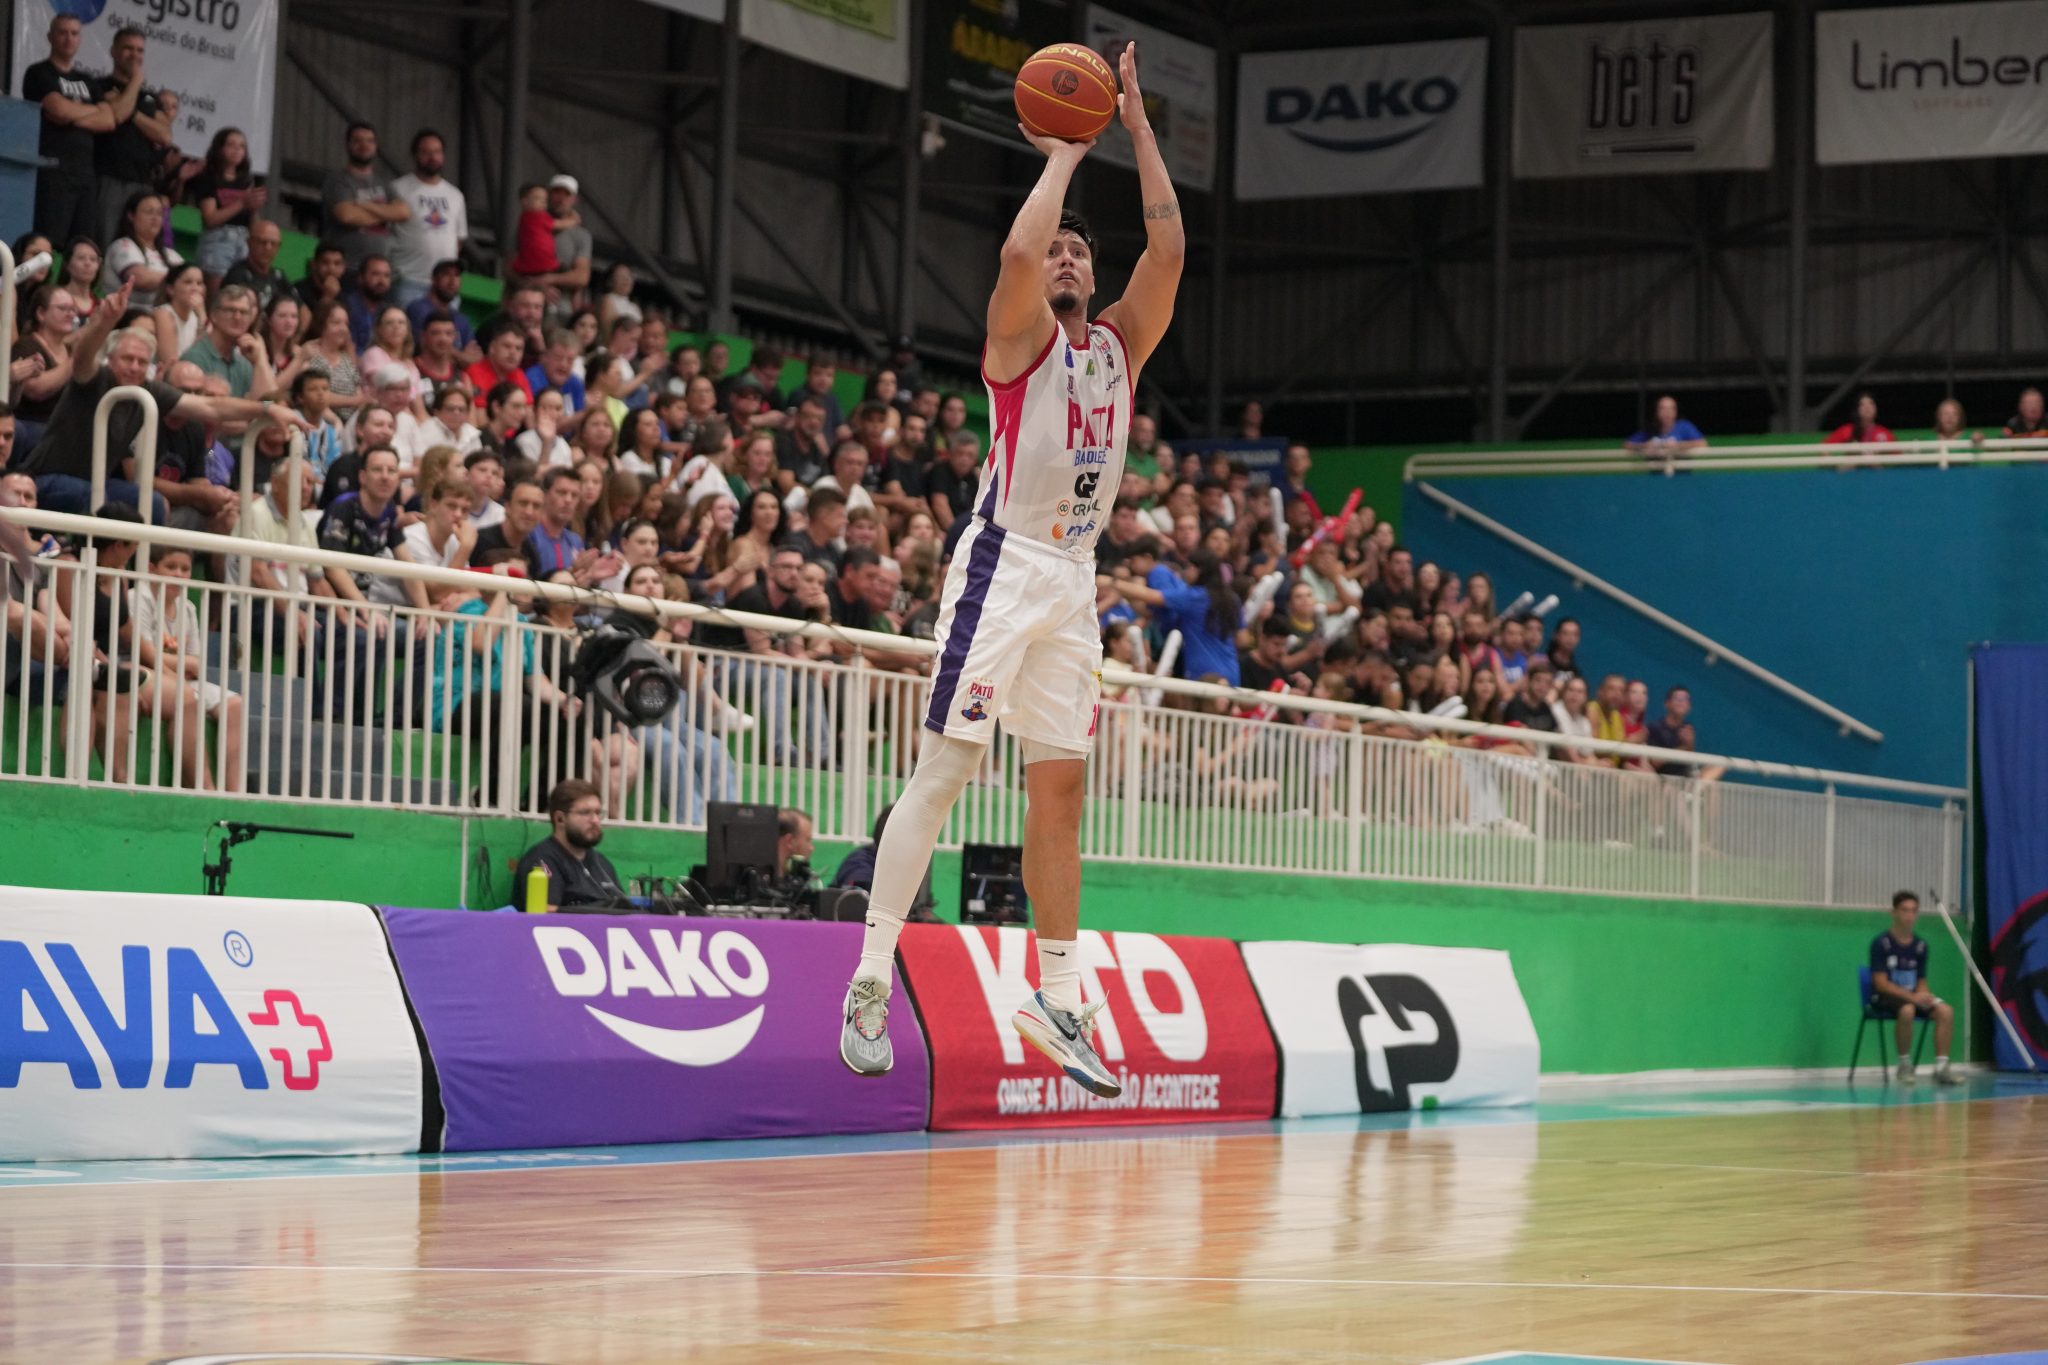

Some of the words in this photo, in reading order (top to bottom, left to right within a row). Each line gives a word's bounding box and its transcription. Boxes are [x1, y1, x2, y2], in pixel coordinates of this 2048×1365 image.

[1033, 46, 1116, 88] PENALTY
[1588, 42, 1697, 129] bets
[1266, 76, 1459, 125] DAKO
[187, 115, 206, 132] PR
[969, 682, 994, 700] PATO
[533, 926, 769, 998] DAKO
[997, 1078, 1043, 1114] ONDE
[1045, 1076, 1057, 1112] A
[1142, 1074, 1221, 1109] ACONTECE
